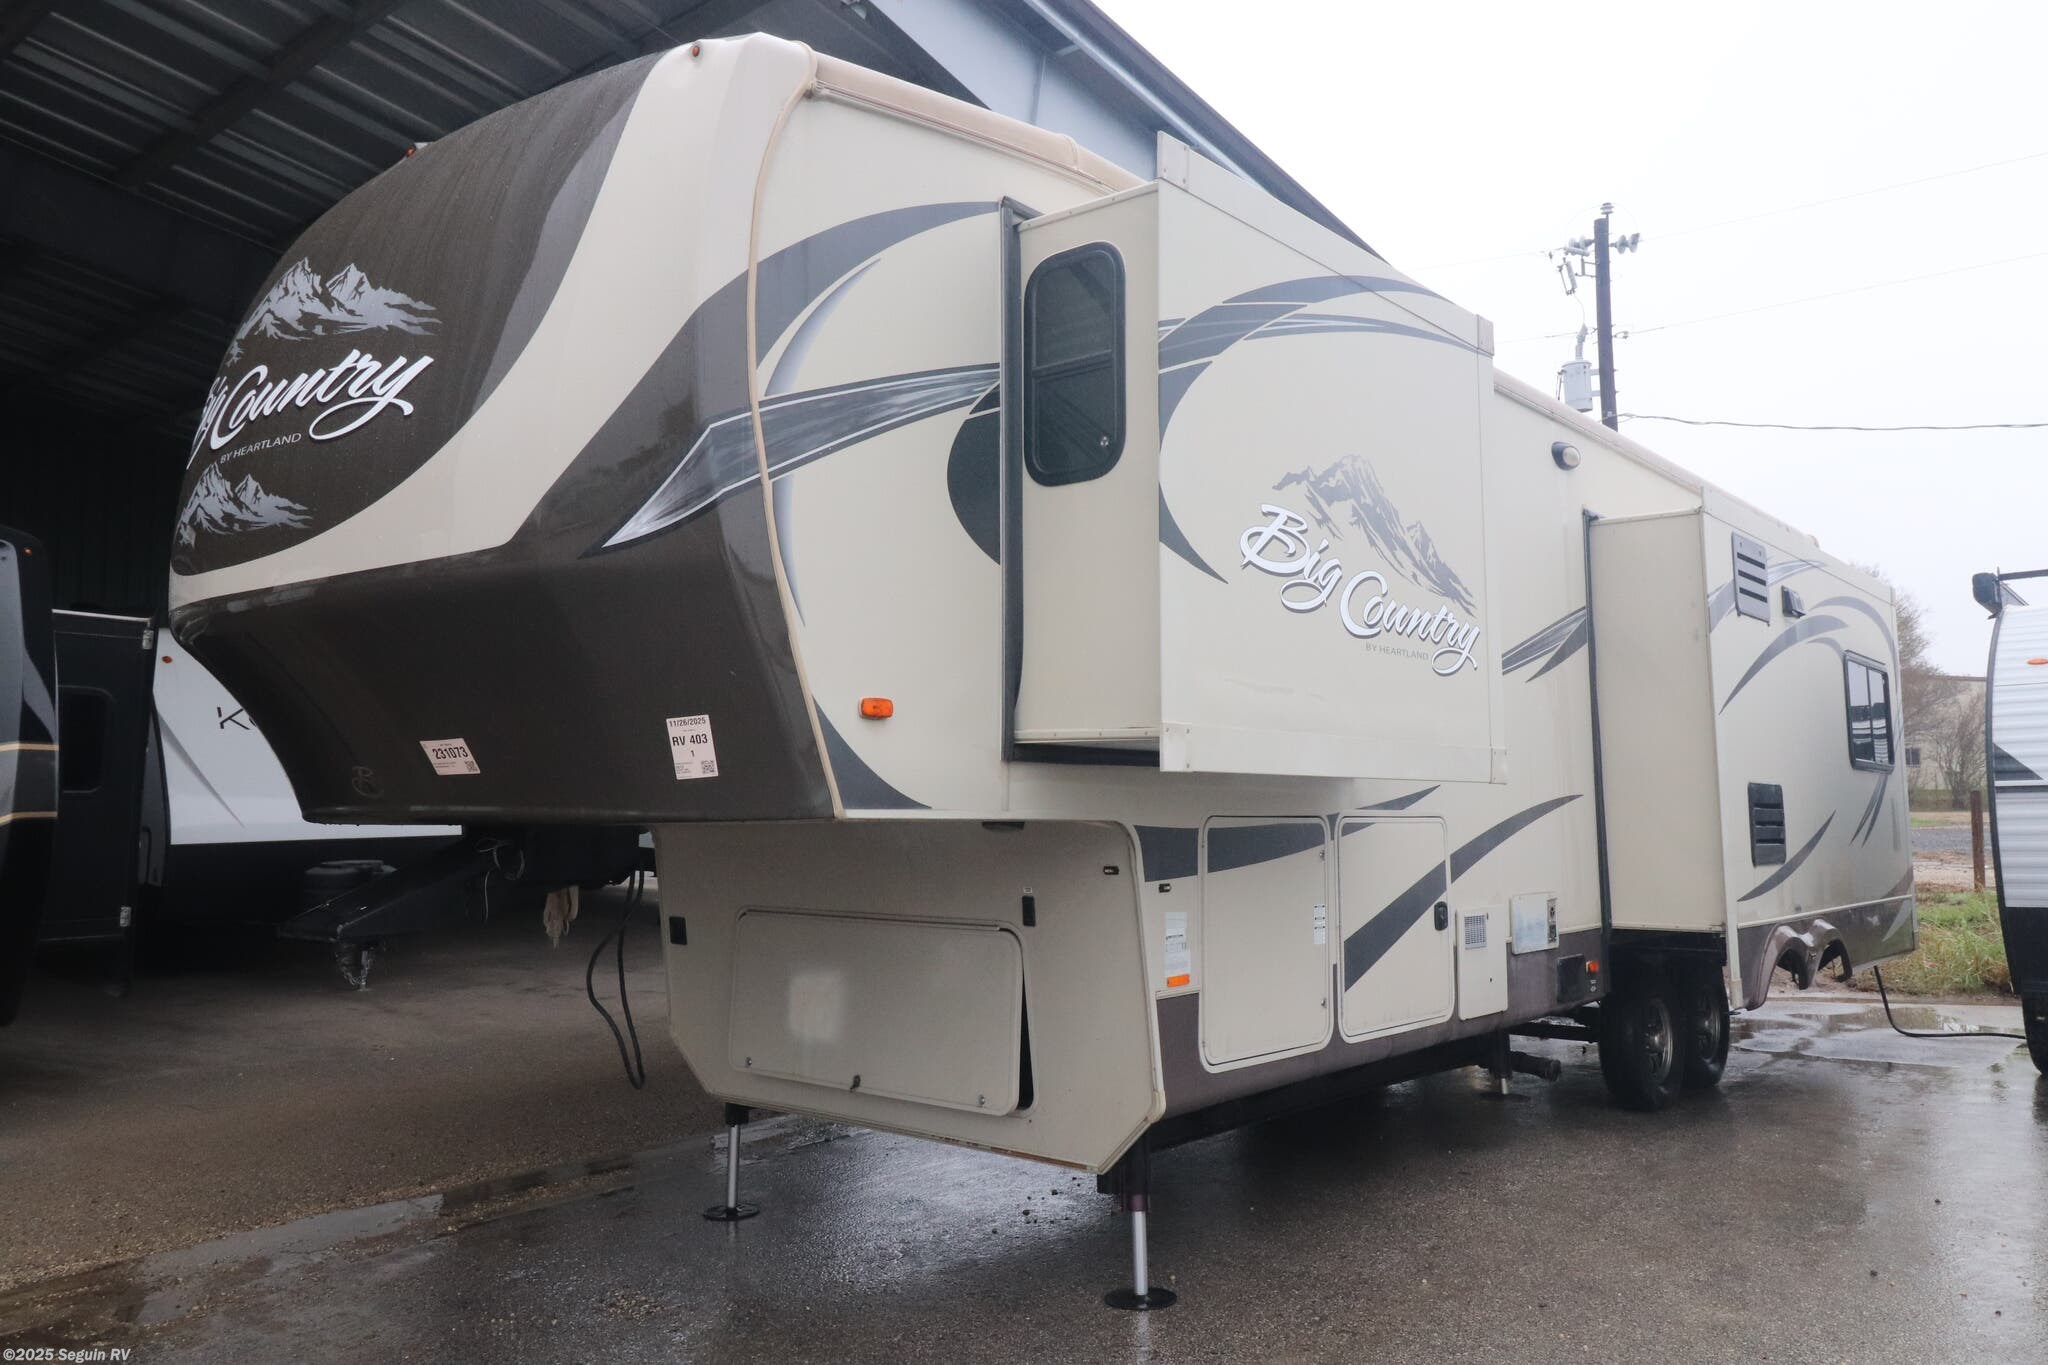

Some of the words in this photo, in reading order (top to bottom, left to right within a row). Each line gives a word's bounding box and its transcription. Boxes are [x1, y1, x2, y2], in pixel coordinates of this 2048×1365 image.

[210, 348, 435, 450] Country
[220, 452, 234, 464] BY
[233, 432, 303, 457] HEARTLAND
[1239, 503, 1343, 614] Big
[1339, 570, 1481, 677] Country
[1365, 642, 1378, 652] BY
[1378, 645, 1430, 661] HEARTLAND
[669, 716, 706, 727] 11/26/2025
[672, 735, 686, 747] RV
[689, 733, 708, 745] 403
[431, 746, 469, 760] 231073
